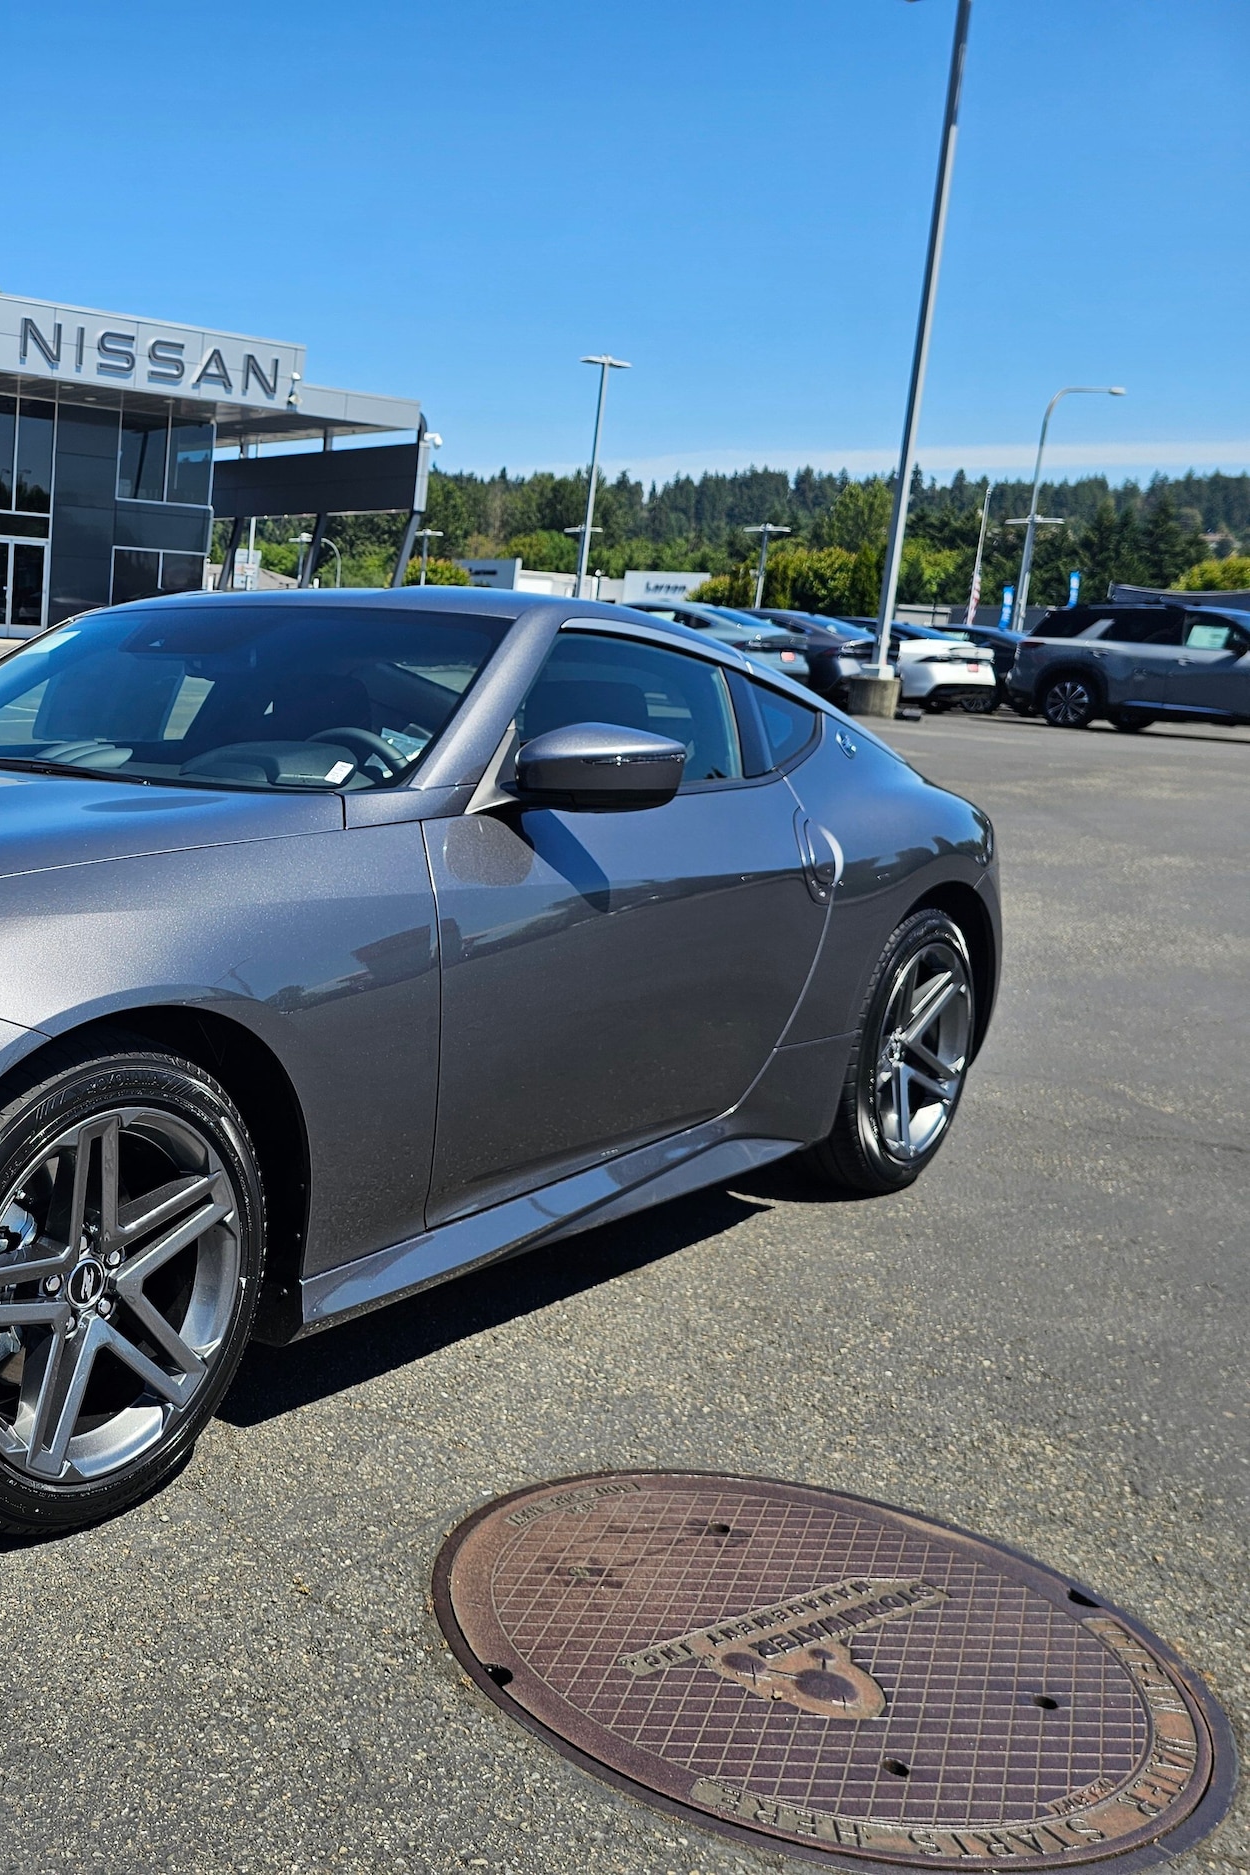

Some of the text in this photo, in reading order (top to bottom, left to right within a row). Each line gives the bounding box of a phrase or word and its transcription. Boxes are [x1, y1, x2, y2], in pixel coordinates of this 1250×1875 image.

[20, 317, 279, 395] NISSAN
[630, 1580, 874, 1668] MANAGEMENT INC.
[749, 1581, 936, 1659] STORMWATER
[1116, 1736, 1199, 1818] WATER
[716, 1787, 863, 1848] HERE
[908, 1817, 1107, 1858] STARTS
